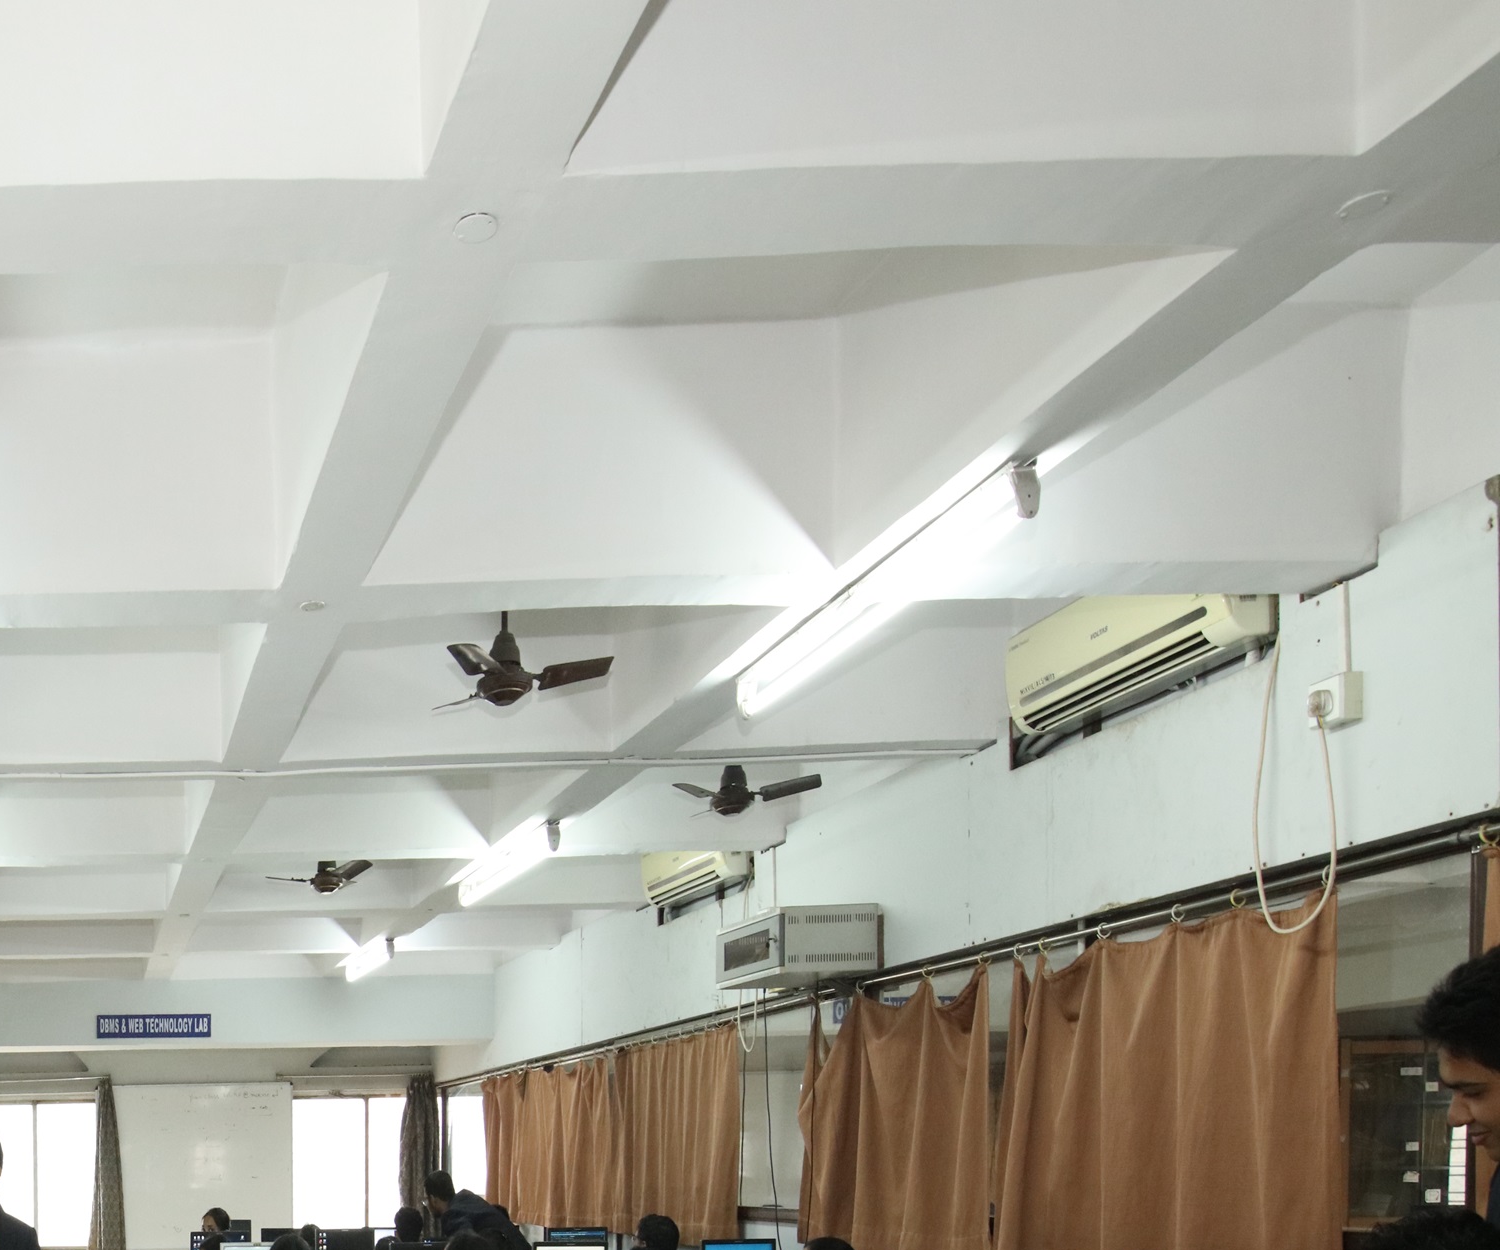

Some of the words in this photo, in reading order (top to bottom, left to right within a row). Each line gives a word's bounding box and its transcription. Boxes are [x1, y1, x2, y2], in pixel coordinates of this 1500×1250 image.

[100, 1018, 119, 1033] DBMS
[121, 1018, 126, 1033] &
[128, 1018, 144, 1033] WEB
[145, 1017, 193, 1033] TECHNOLOGY
[194, 1017, 208, 1033] LAB
